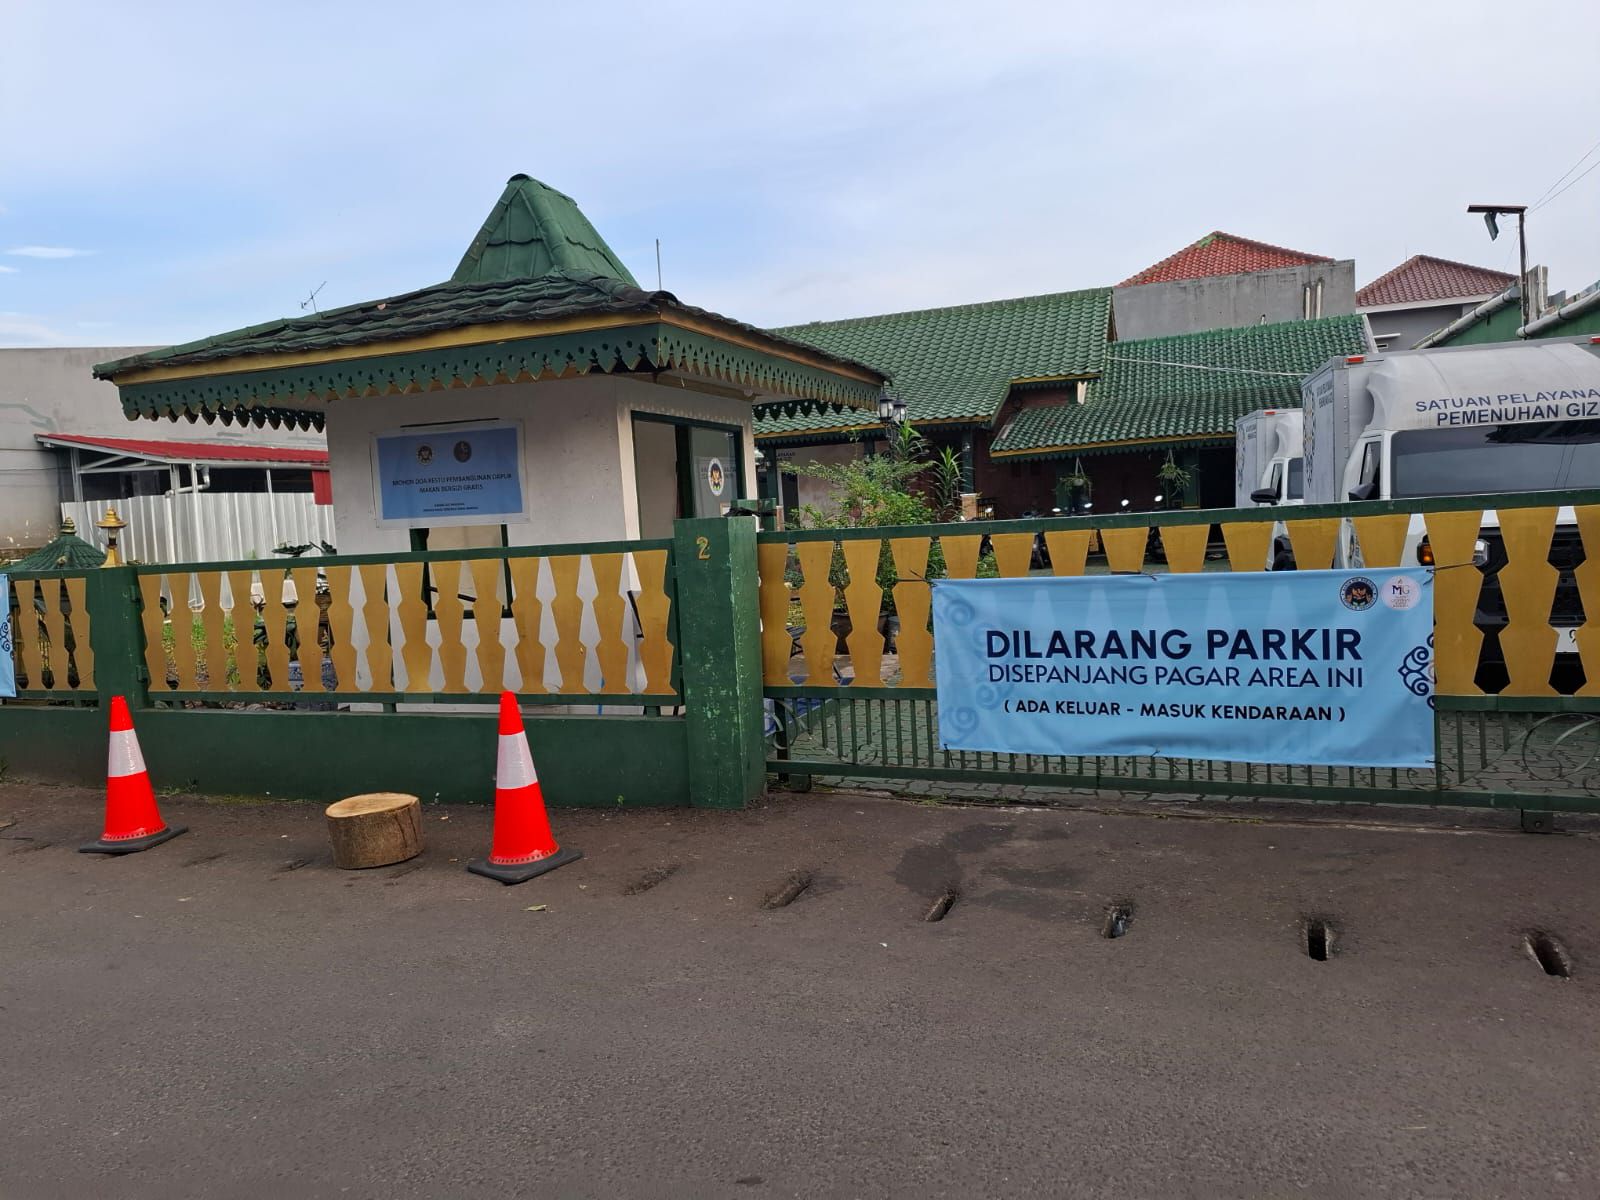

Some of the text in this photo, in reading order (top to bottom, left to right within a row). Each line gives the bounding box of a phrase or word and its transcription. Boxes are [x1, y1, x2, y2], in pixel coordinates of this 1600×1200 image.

[1415, 388, 1600, 412] SATUAN PELAYANA
[1437, 401, 1599, 426] PEMENUHAN GIZ
[696, 536, 711, 560] 2
[986, 629, 1363, 660] DILARANG PARKIR
[989, 664, 1363, 688] DISEPANJANG PAGAR AREA INI
[1016, 700, 1050, 714] ADA
[1055, 700, 1121, 716] KELUAR
[1140, 703, 1206, 718] MASUK
[1211, 704, 1332, 721] KENDARAAN
